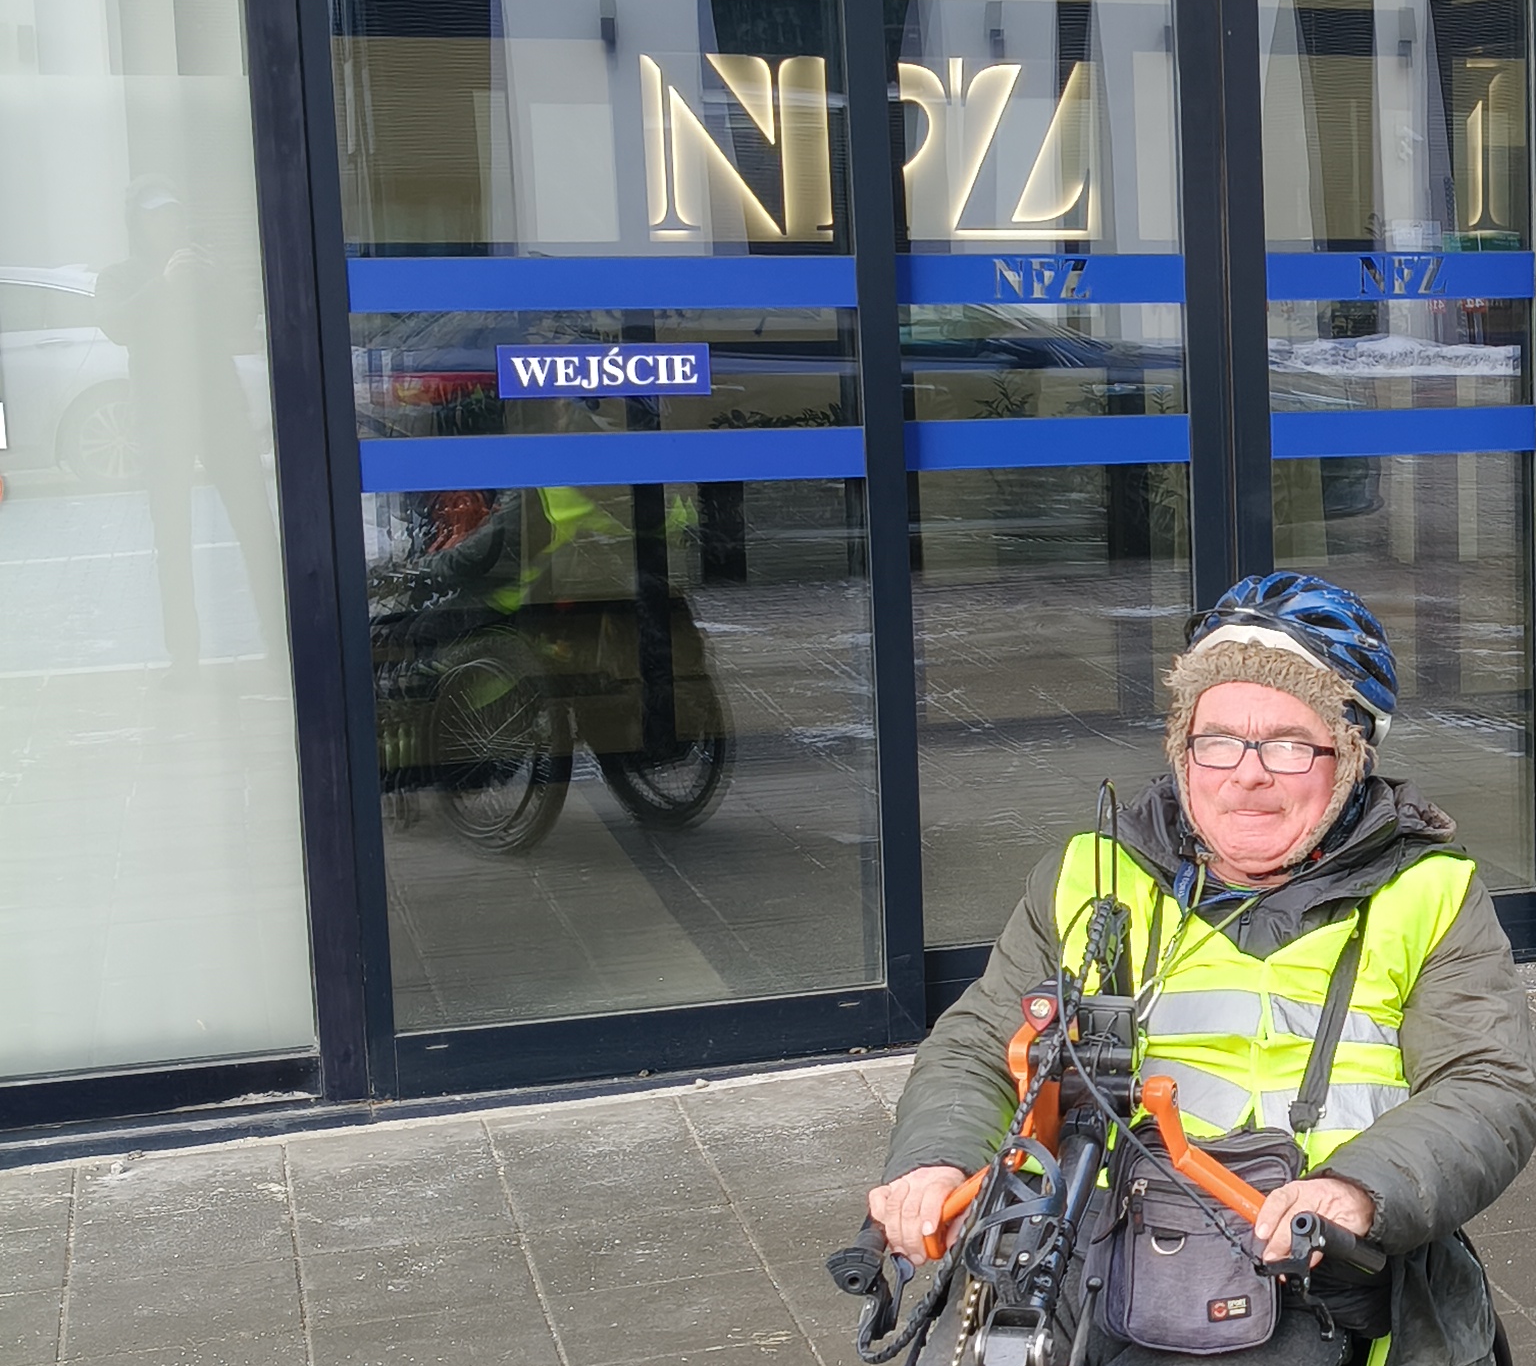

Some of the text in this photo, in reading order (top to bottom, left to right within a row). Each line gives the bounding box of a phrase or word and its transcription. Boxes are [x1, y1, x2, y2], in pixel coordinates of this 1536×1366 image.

[992, 258, 1091, 299] NFZ
[1358, 256, 1448, 295] NFZ
[511, 347, 697, 388] WEJŚCIE
